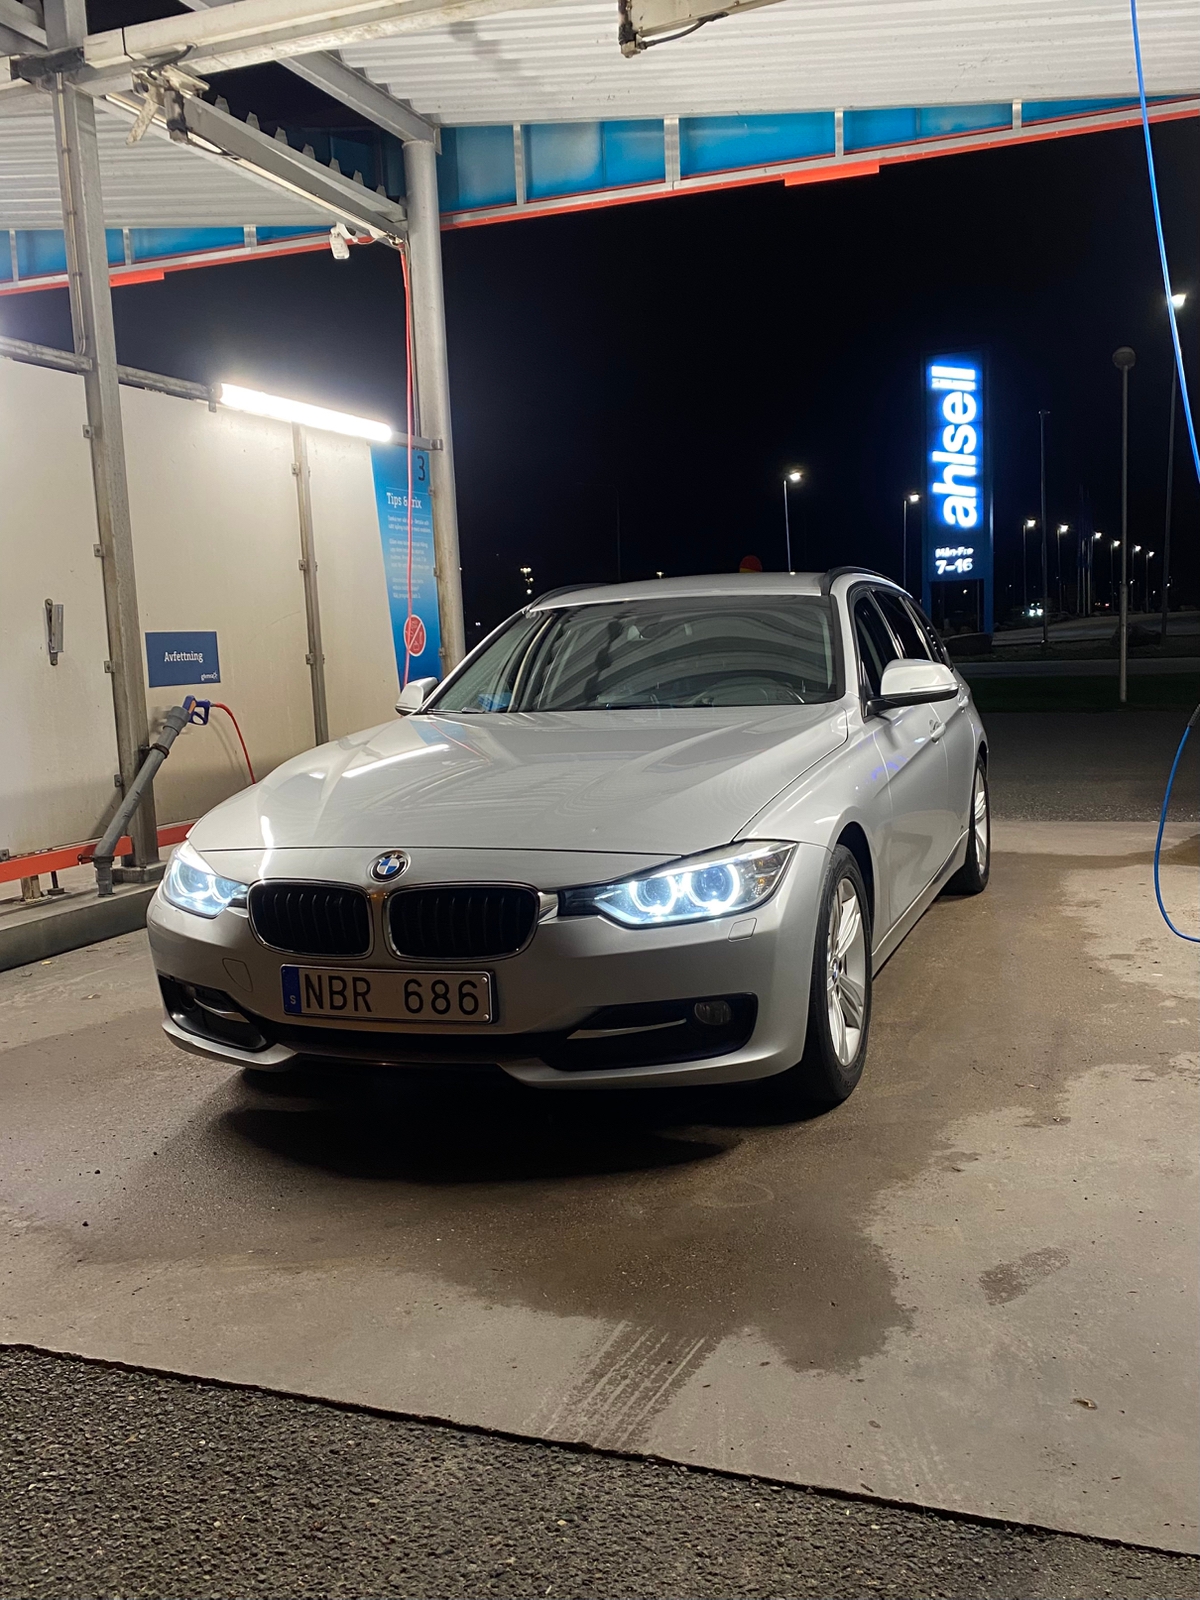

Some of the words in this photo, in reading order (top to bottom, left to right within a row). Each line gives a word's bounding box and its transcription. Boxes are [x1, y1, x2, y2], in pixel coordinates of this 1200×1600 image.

[931, 366, 977, 528] ahlsell
[417, 455, 426, 481] 3
[386, 492, 402, 508] Tips
[935, 558, 973, 575] 7-16
[164, 651, 203, 663] Avfettning
[290, 995, 296, 1005] S
[304, 973, 372, 1013] NBR
[403, 978, 479, 1015] 686
